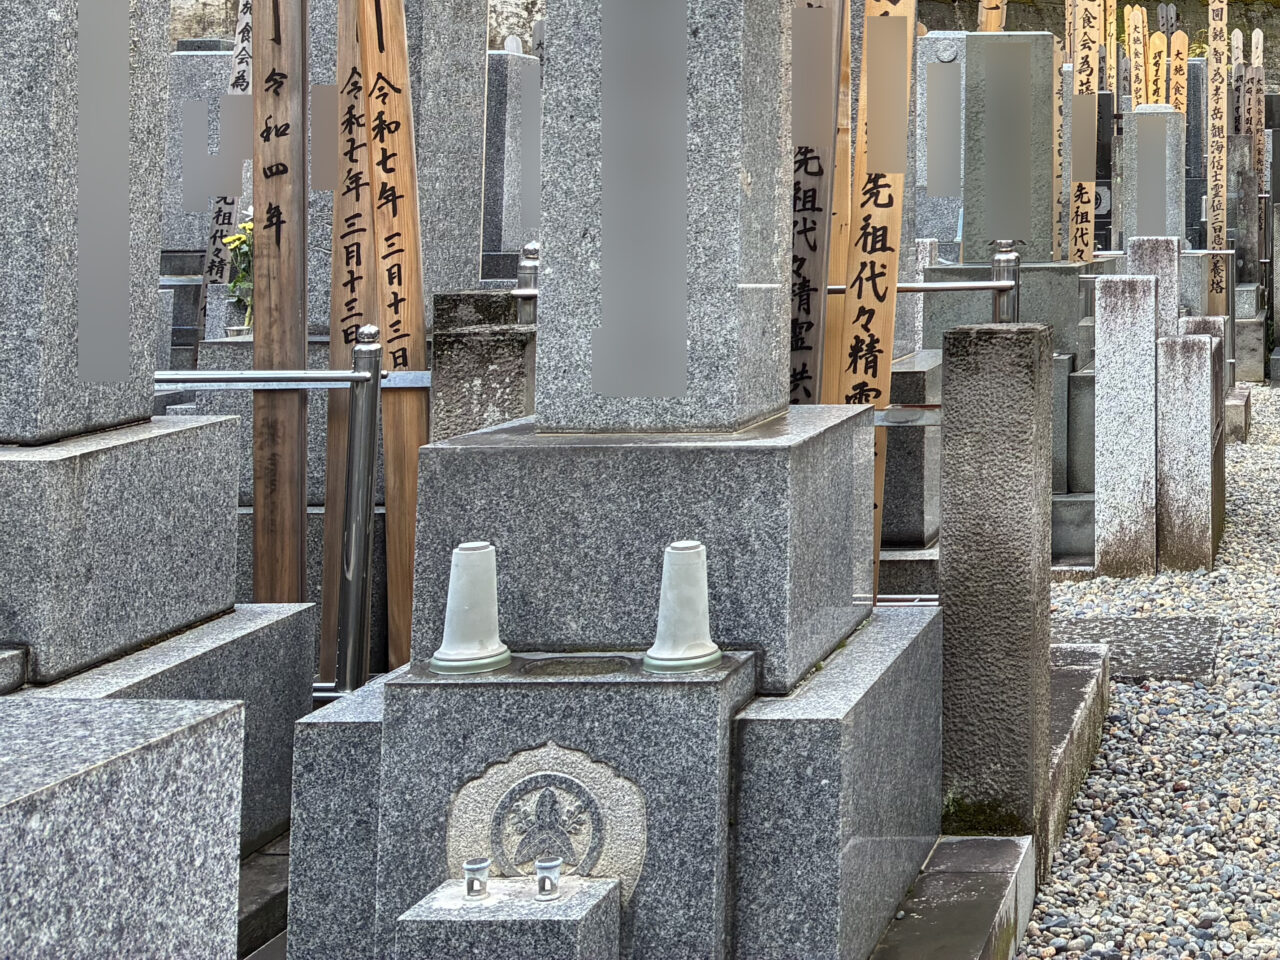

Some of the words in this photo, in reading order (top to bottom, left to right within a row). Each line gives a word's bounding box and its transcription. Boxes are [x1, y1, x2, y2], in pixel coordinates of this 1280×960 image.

[259, 67, 290, 246] 令和四年
[368, 71, 411, 368] 令和七年三月十三日
